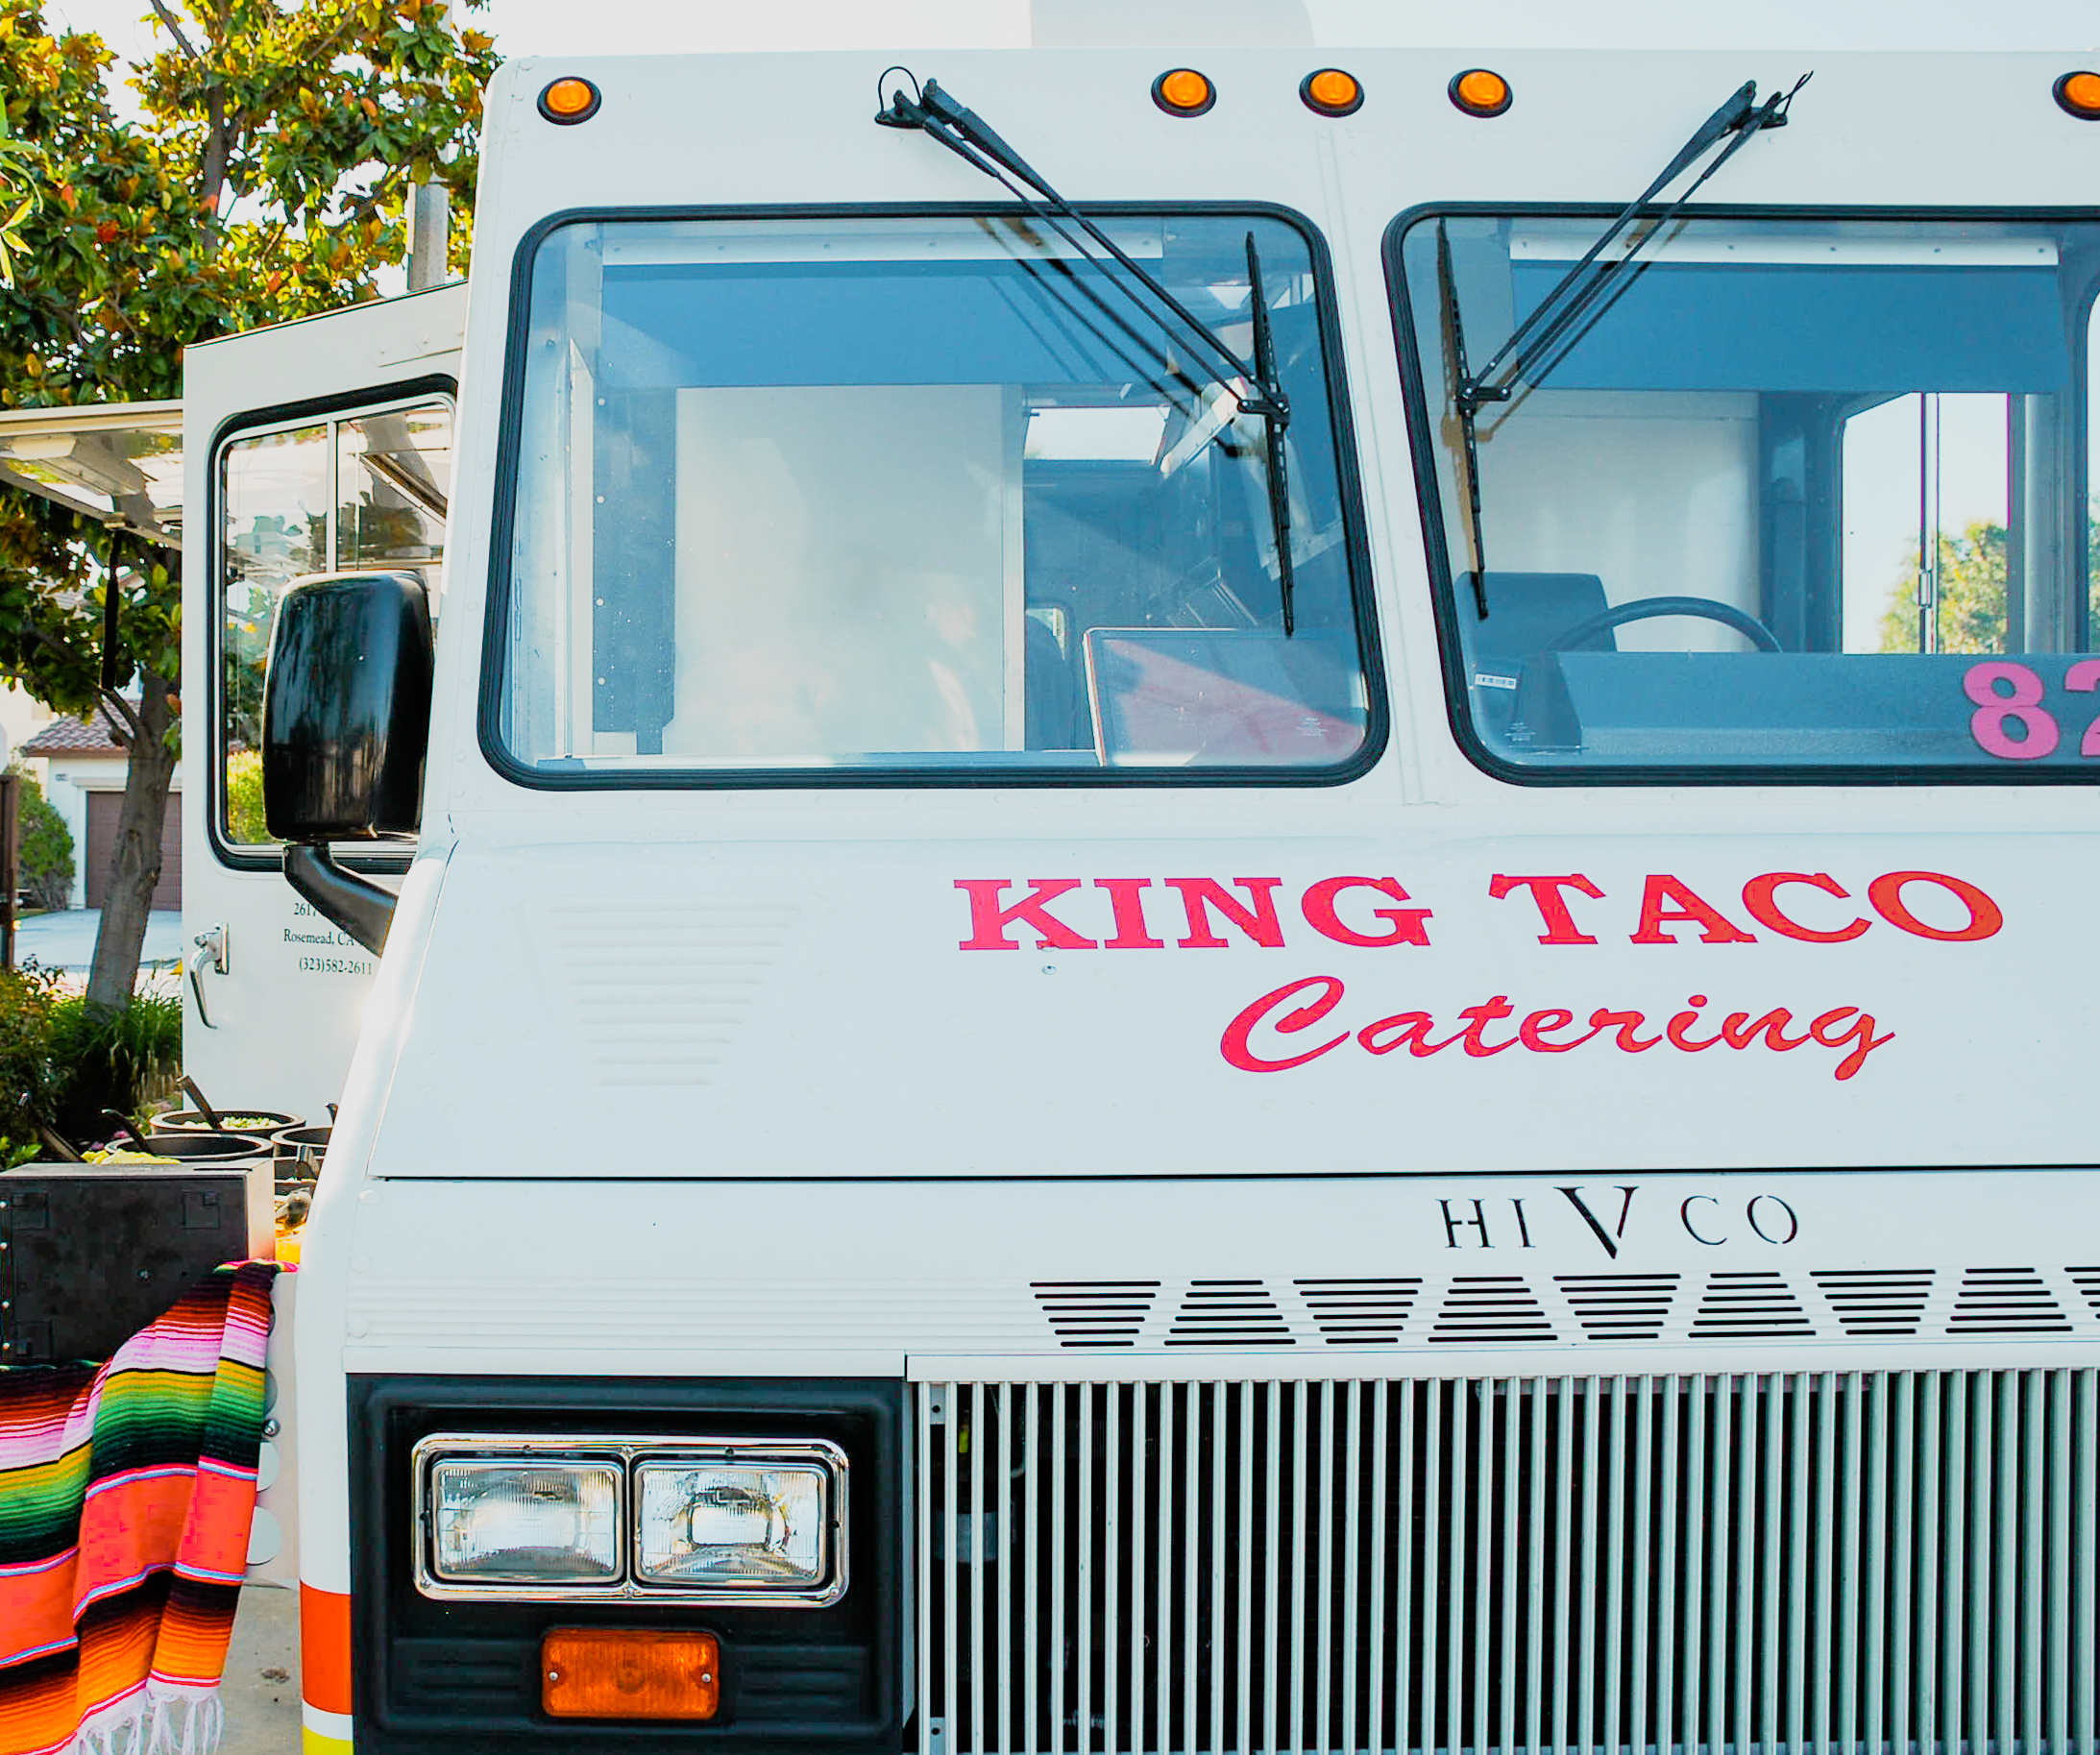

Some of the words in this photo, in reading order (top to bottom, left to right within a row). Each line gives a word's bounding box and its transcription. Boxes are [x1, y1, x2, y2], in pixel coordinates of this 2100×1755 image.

[953, 876, 1434, 951] KING
[1488, 870, 2004, 945] TACO
[283, 928, 334, 946] Rosemead,
[299, 957, 372, 975] (323)582-2611
[1220, 975, 1896, 1082] Catering
